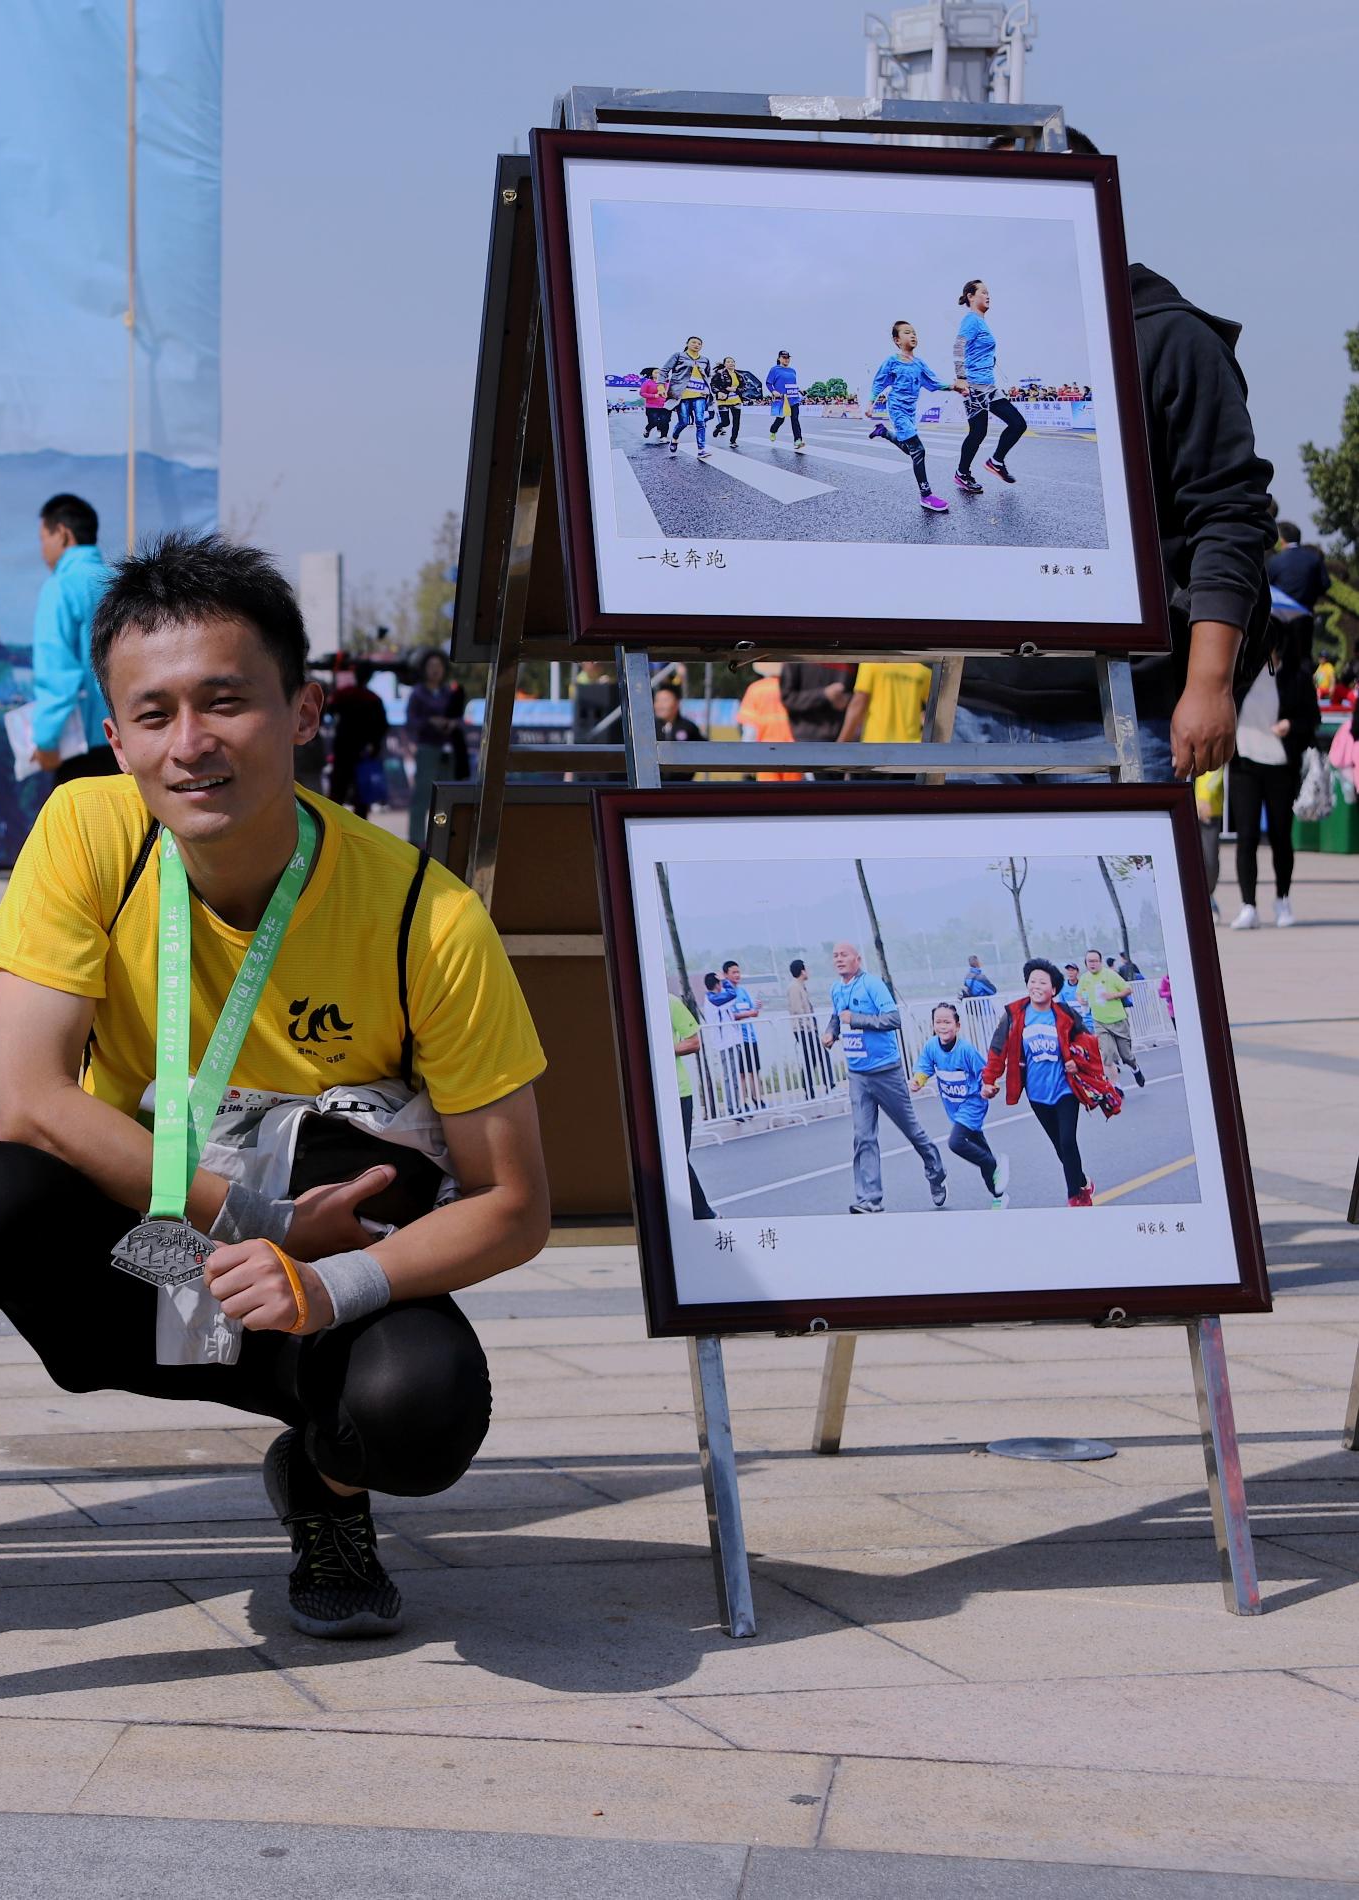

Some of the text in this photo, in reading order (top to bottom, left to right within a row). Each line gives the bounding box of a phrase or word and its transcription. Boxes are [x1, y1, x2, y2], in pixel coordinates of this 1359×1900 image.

[636, 548, 727, 570] 一起奔跑
[209, 916, 277, 1070] 2018池州国际马拉松
[241, 964, 267, 1022] INTERNATIONAL
[264, 920, 284, 961] MARATHON
